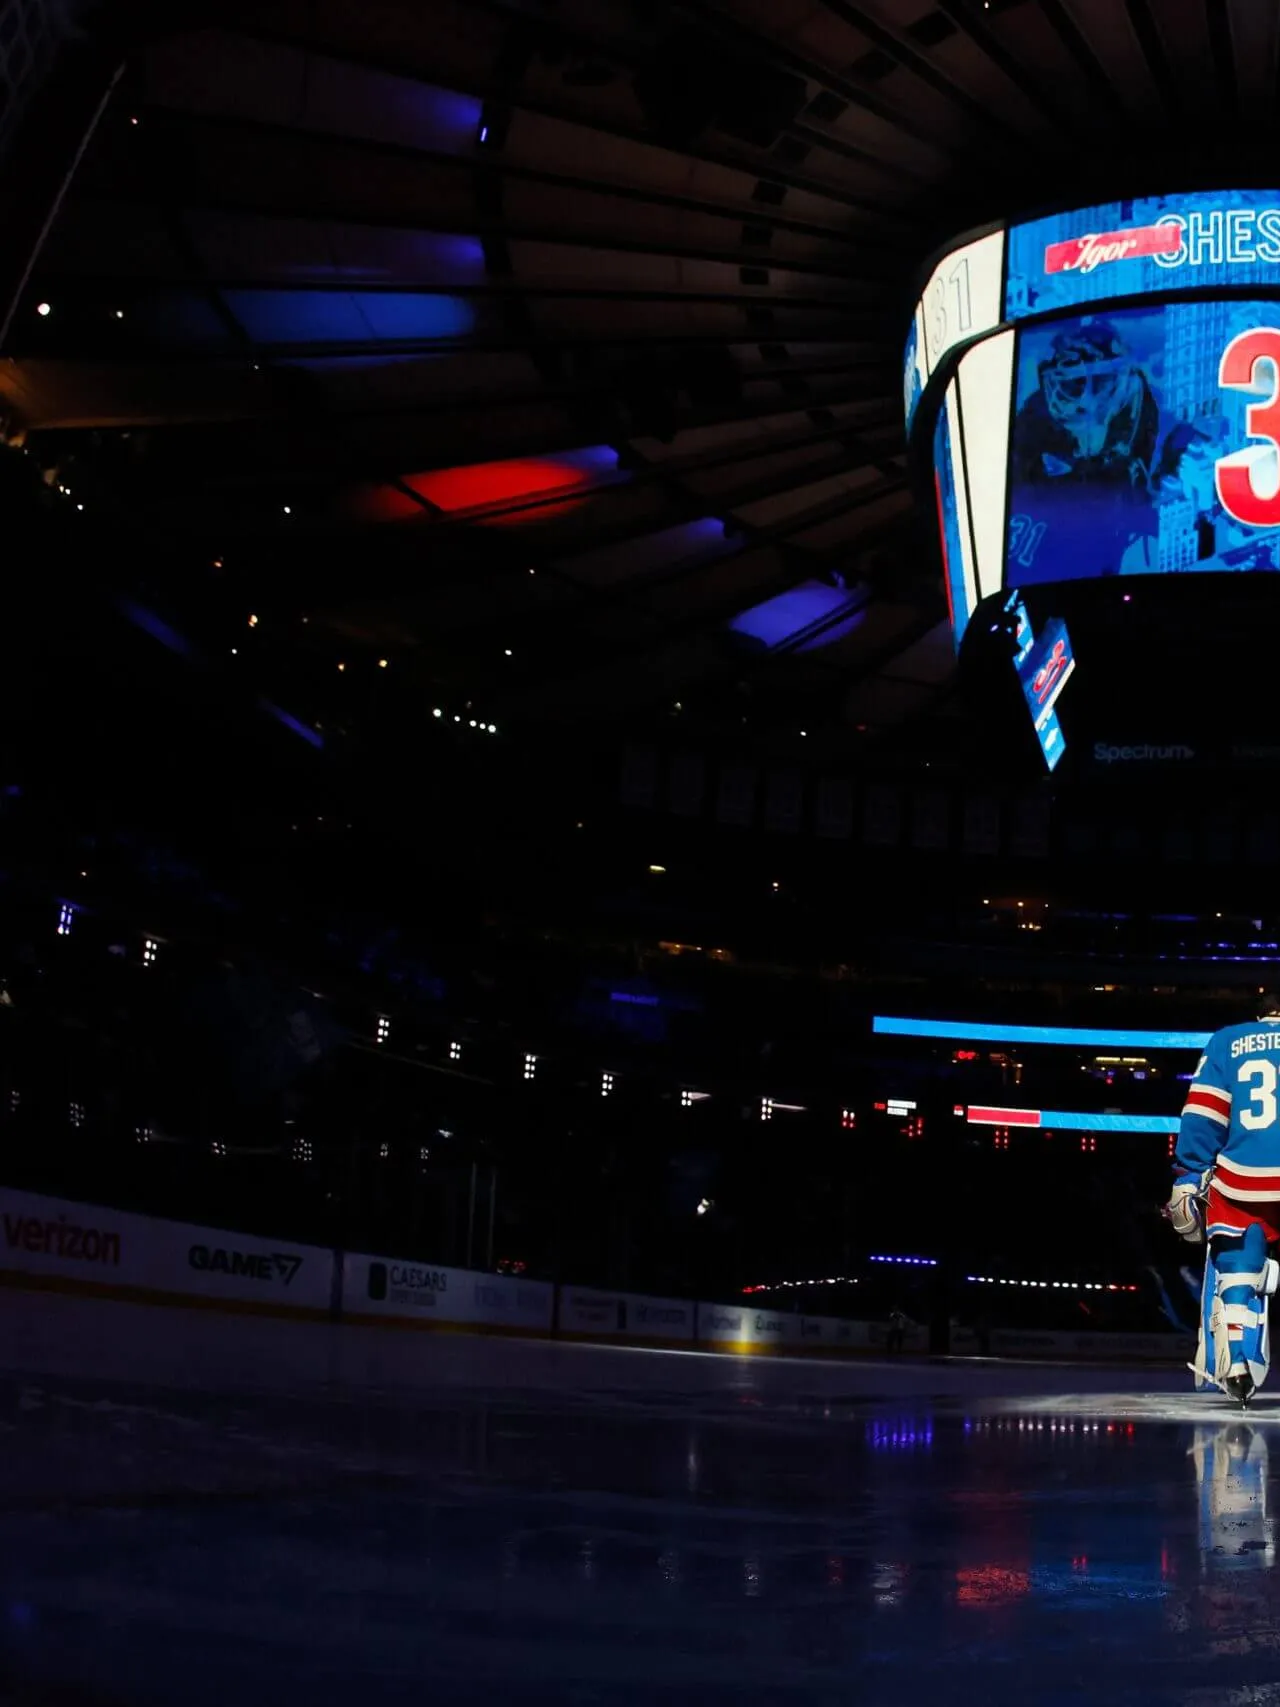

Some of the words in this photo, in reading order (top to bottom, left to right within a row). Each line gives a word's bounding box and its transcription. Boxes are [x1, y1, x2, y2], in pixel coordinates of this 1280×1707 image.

[1063, 233, 1137, 273] Igor
[1094, 742, 1188, 764] Spectrum
[3, 1212, 121, 1266] verizon
[391, 1265, 447, 1291] CAESARS
